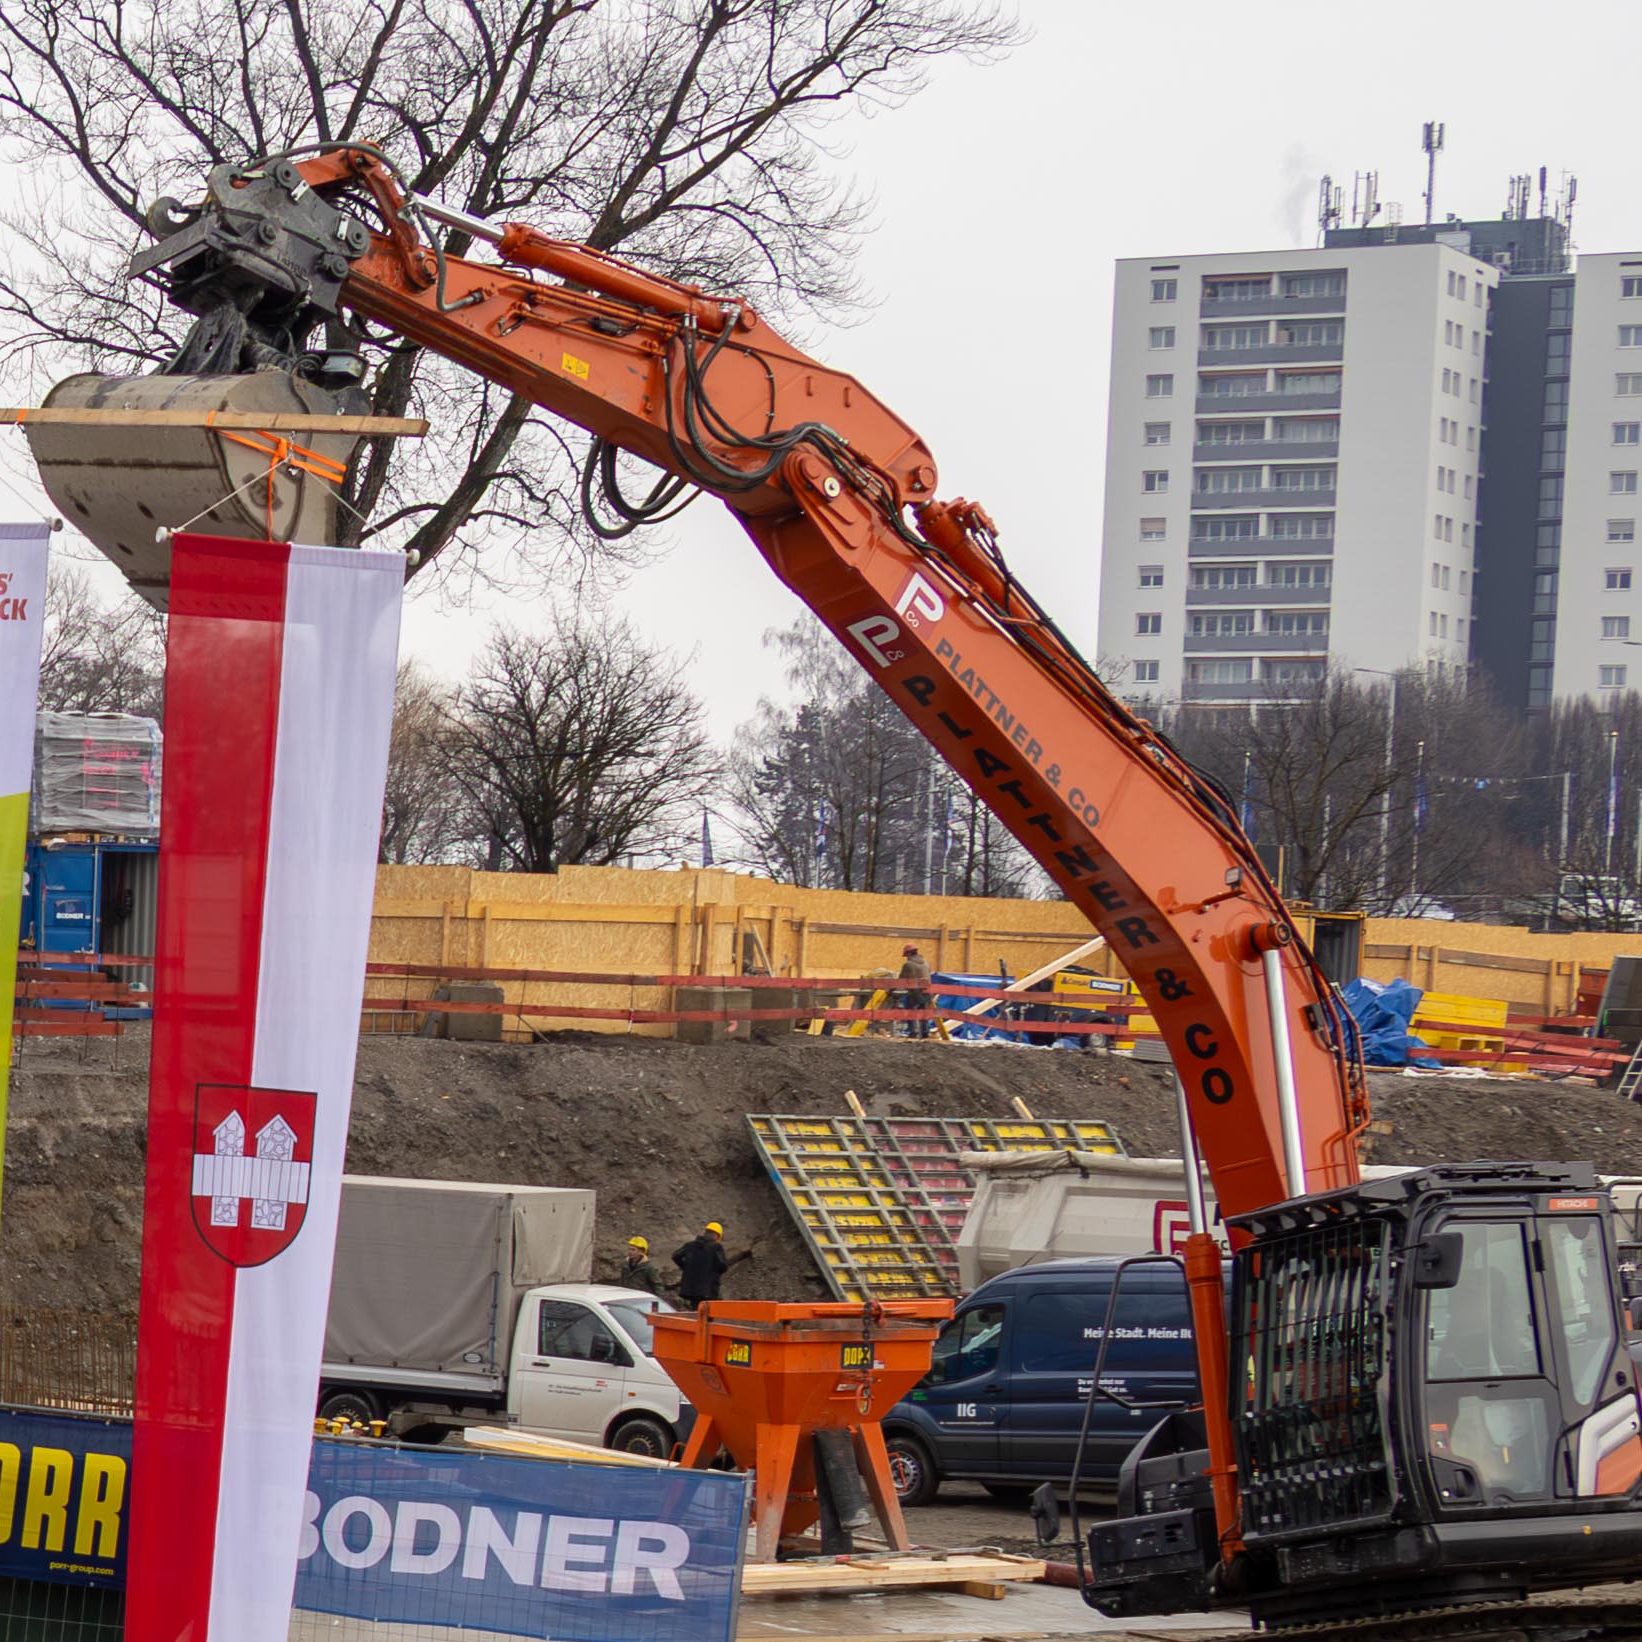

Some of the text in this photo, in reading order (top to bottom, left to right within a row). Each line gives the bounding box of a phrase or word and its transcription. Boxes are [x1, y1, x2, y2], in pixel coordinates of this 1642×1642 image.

[935, 638, 1100, 829] PLATTNER & CO
[901, 674, 1234, 1105] PLATTNER & CO
[1084, 1327, 1114, 1338] Meie
[957, 1403, 977, 1417] IIG
[49, 1561, 114, 1576] porr-group.com
